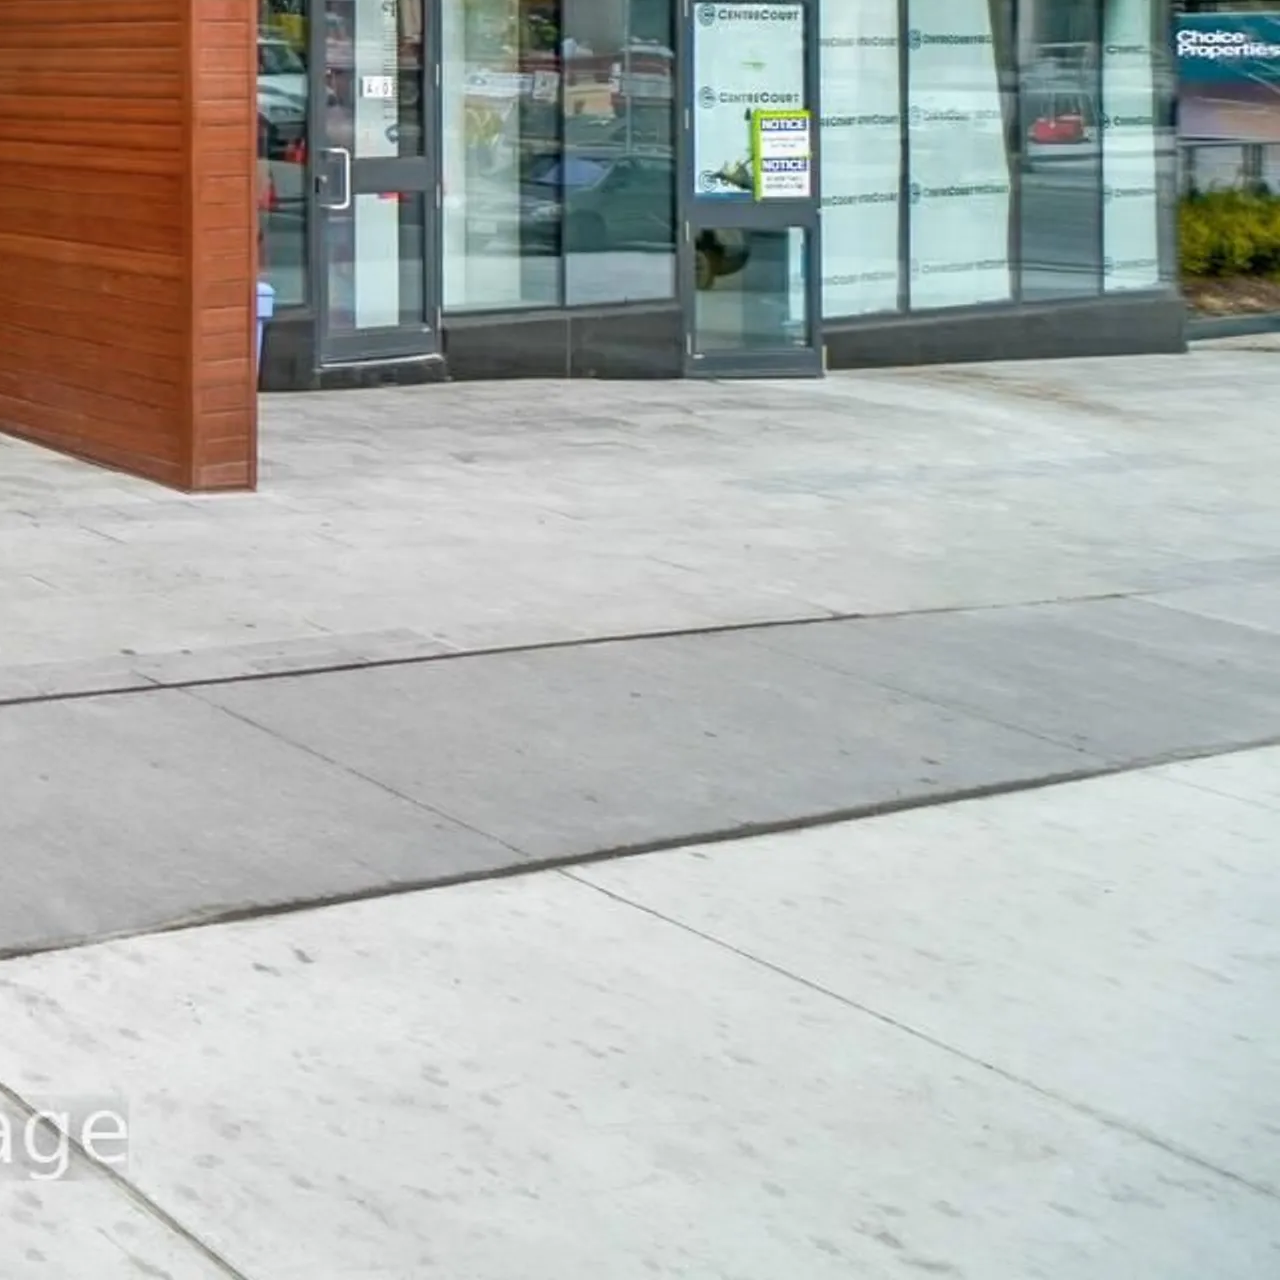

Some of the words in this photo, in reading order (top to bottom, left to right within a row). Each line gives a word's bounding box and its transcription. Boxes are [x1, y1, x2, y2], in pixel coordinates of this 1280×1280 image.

[1176, 29, 1244, 44] Choice
[1177, 42, 1280, 59] Properties
[761, 118, 807, 131] NOTICE
[761, 158, 807, 171] NOTICE
